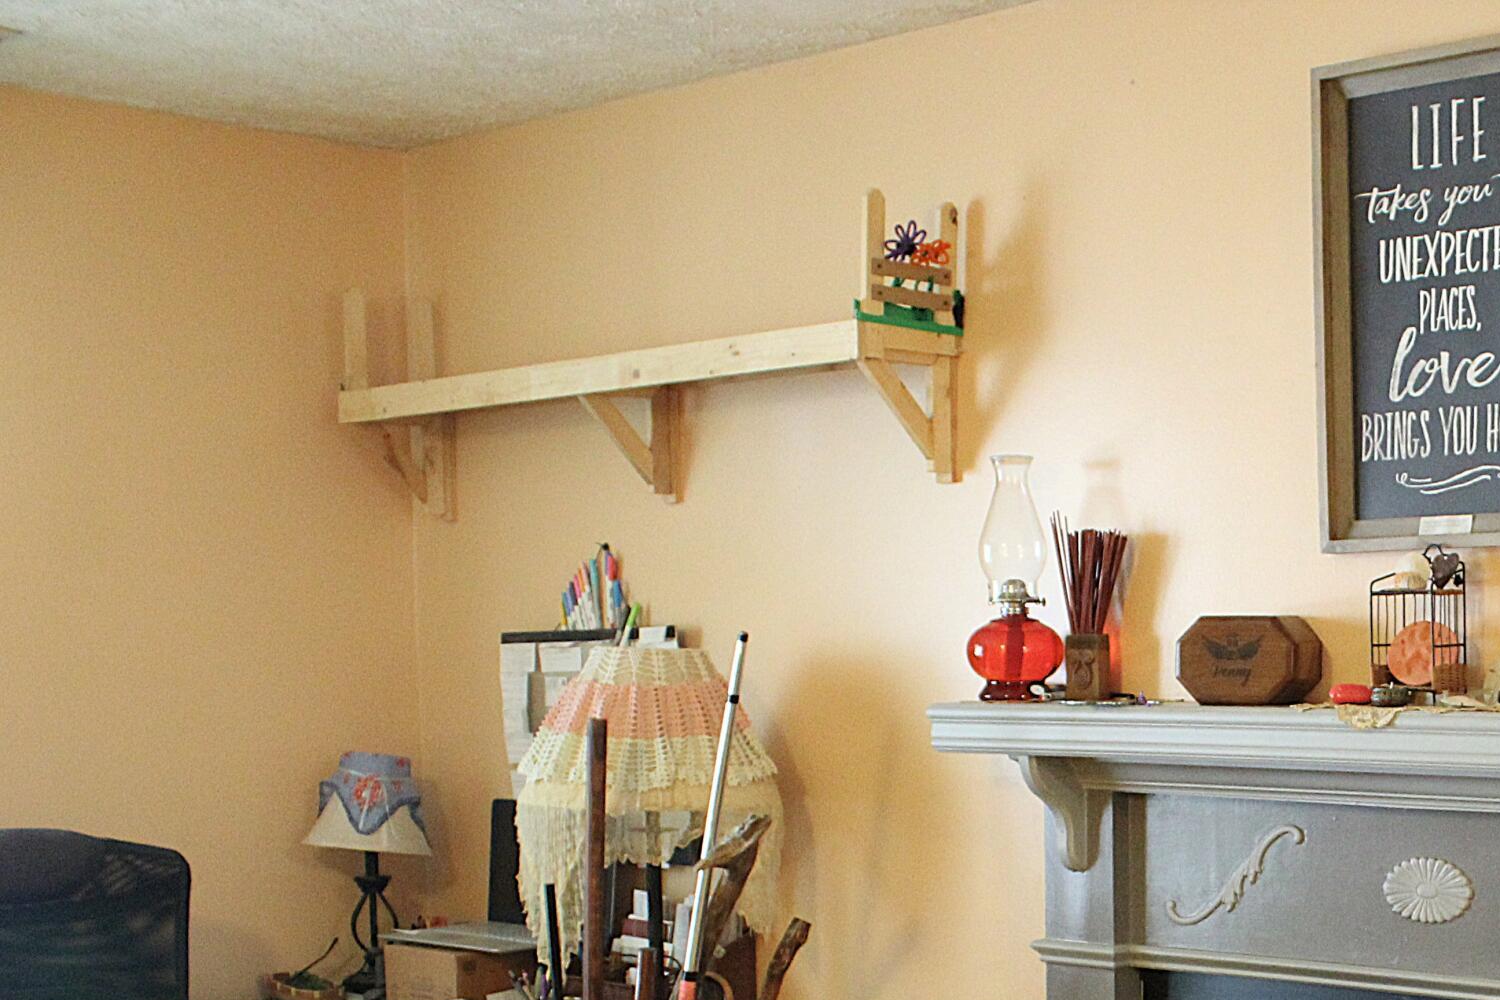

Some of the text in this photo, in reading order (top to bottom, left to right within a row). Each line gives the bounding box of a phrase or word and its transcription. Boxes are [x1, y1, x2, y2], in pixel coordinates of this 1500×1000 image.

[1411, 96, 1487, 170] LIFE
[1355, 184, 1432, 224] takes
[1438, 184, 1491, 226] you
[1419, 285, 1482, 335] PLACES,
[1361, 409, 1431, 462] BRINGS
[1438, 405, 1478, 457] YOU
